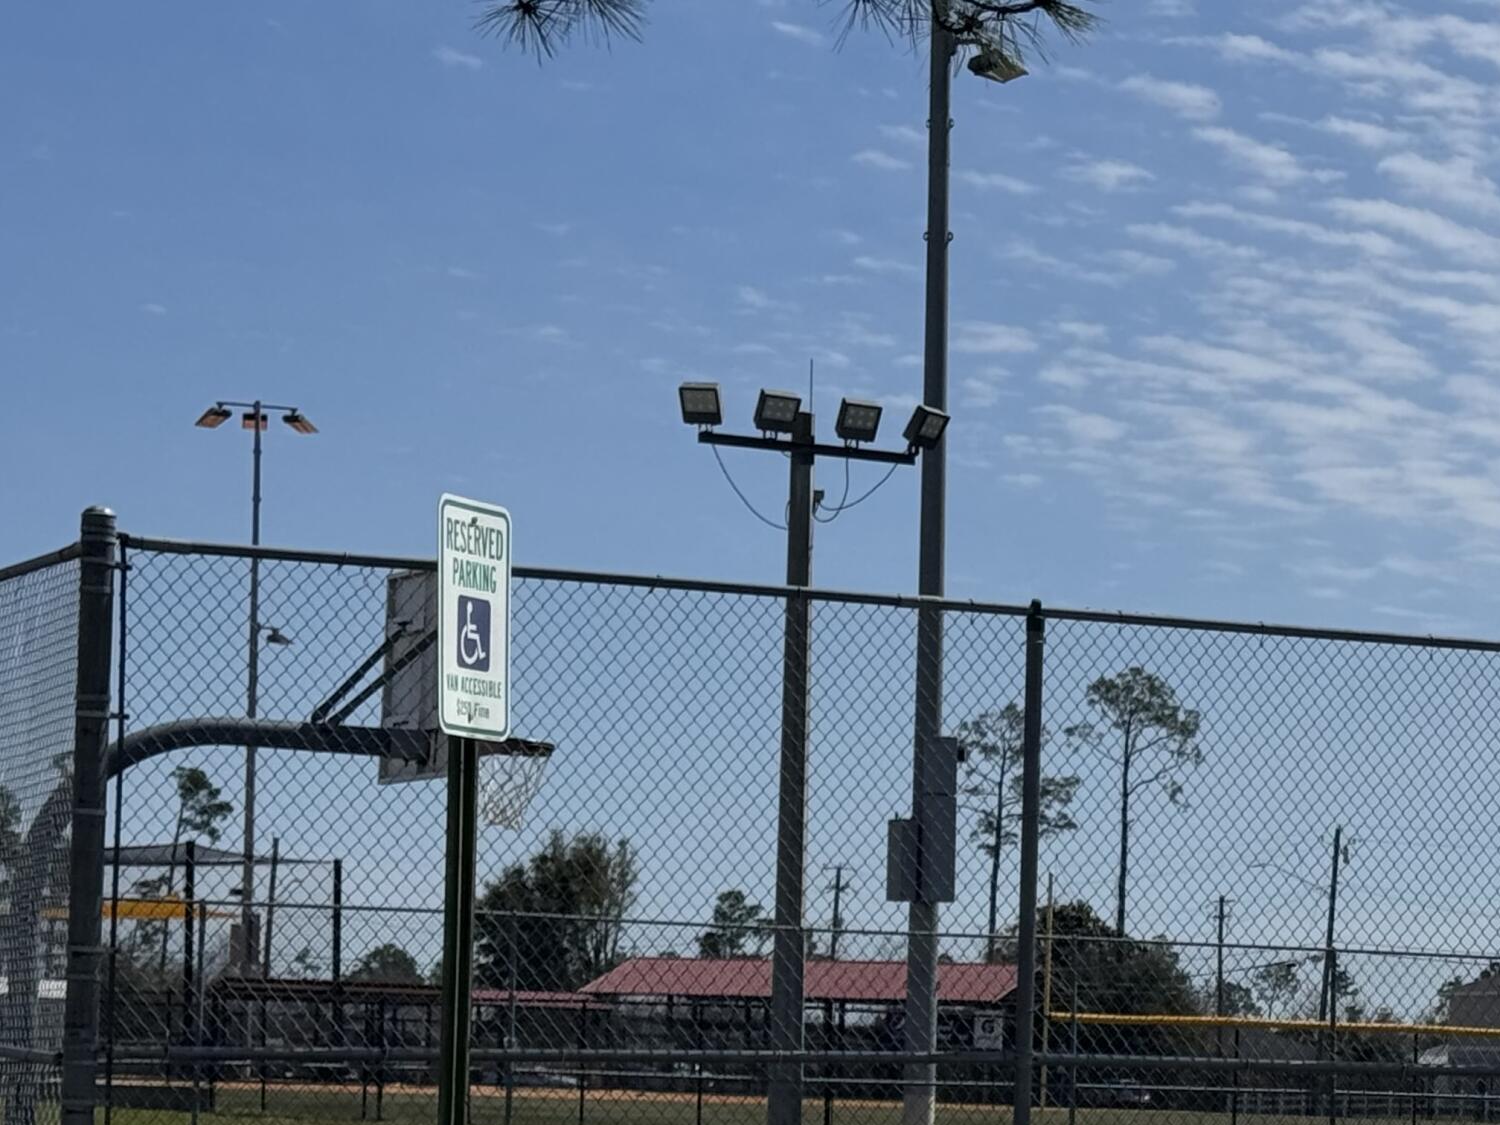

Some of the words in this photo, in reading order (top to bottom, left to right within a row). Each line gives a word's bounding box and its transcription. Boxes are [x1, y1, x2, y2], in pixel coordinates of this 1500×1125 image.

[446, 517, 503, 561] RESERVED
[453, 557, 496, 593] PARKING
[446, 673, 459, 692] VAN
[461, 676, 502, 699] ACCESSIBLE
